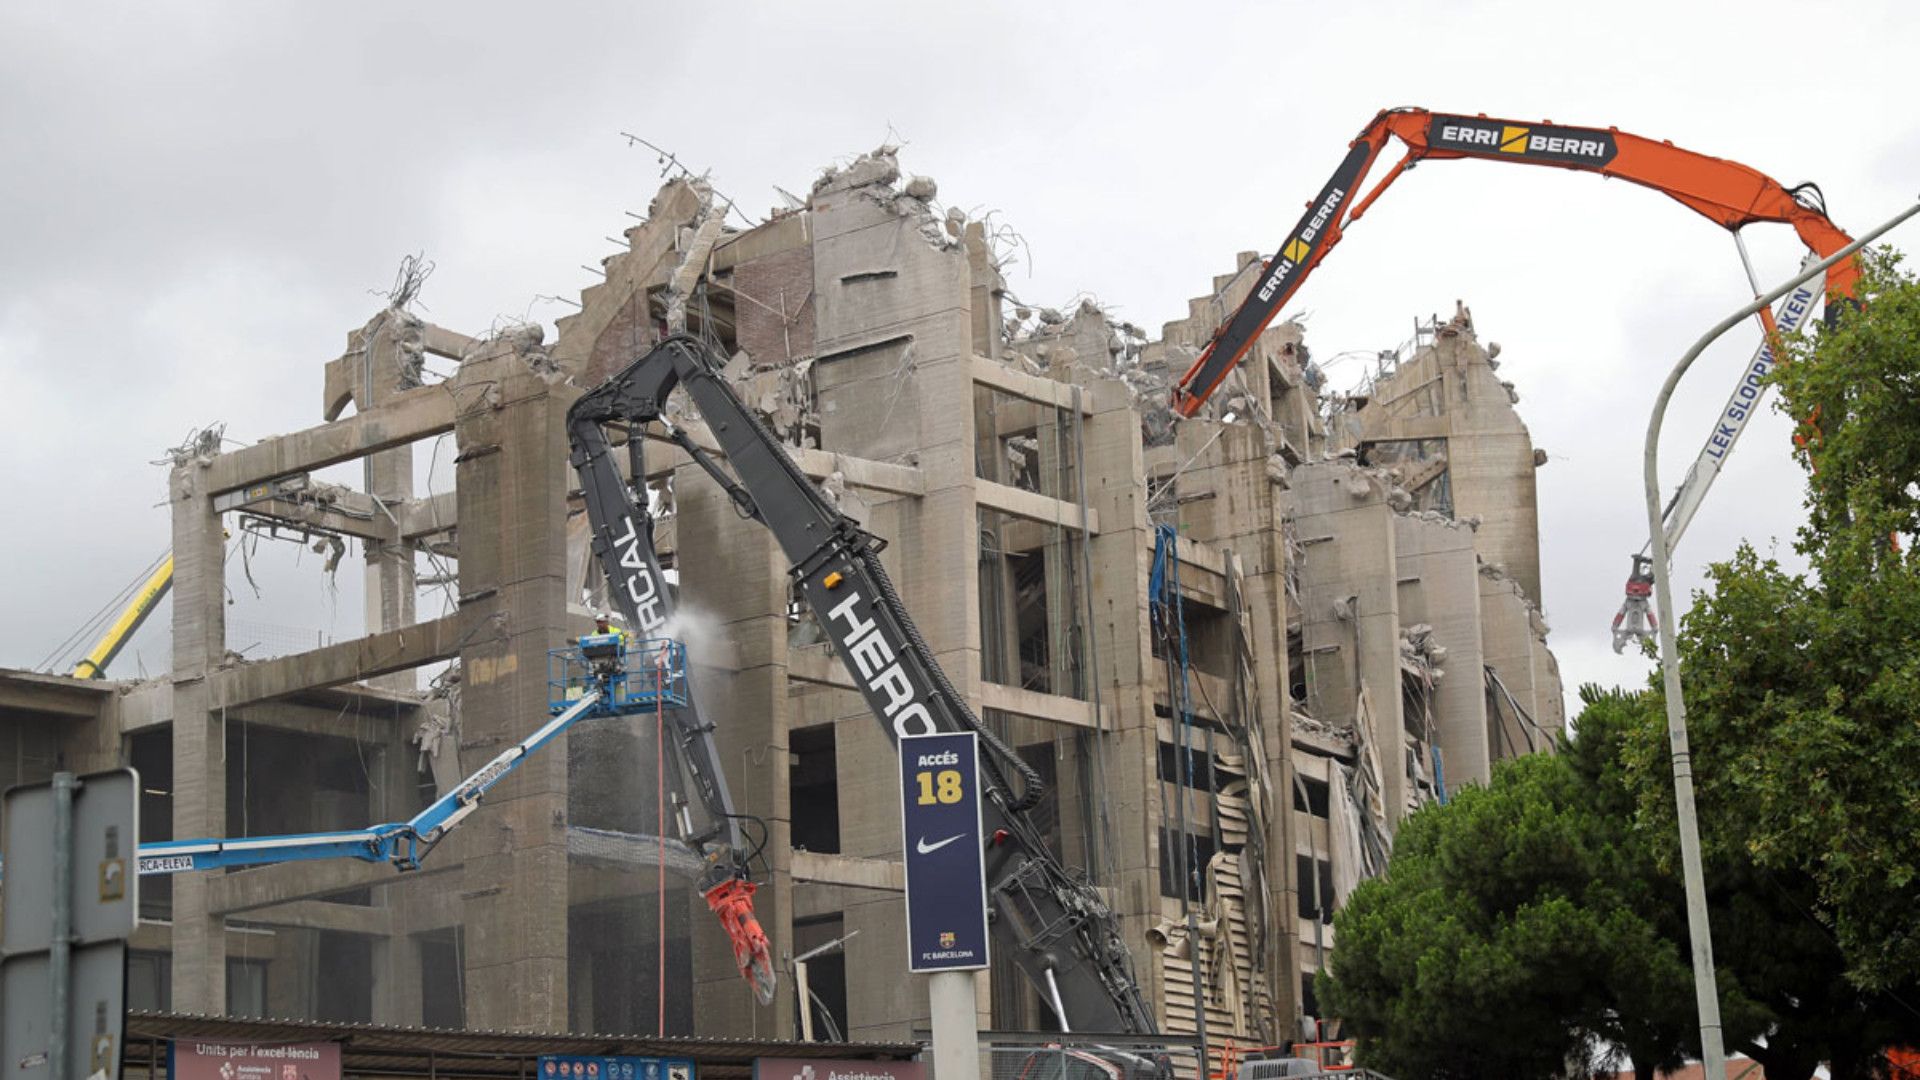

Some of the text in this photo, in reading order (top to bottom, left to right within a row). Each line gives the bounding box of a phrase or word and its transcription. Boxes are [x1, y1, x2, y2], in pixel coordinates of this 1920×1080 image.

[1442, 126, 1605, 157] ERRI BERRI
[1258, 187, 1344, 302] ERRI BERRI
[1707, 423, 1737, 459] LEK
[918, 750, 958, 767] ACCÉS
[916, 770, 963, 806] 18
[922, 951, 973, 960] FC BARCELONA
[196, 1043, 226, 1057] Units
[230, 1047, 248, 1058] per
